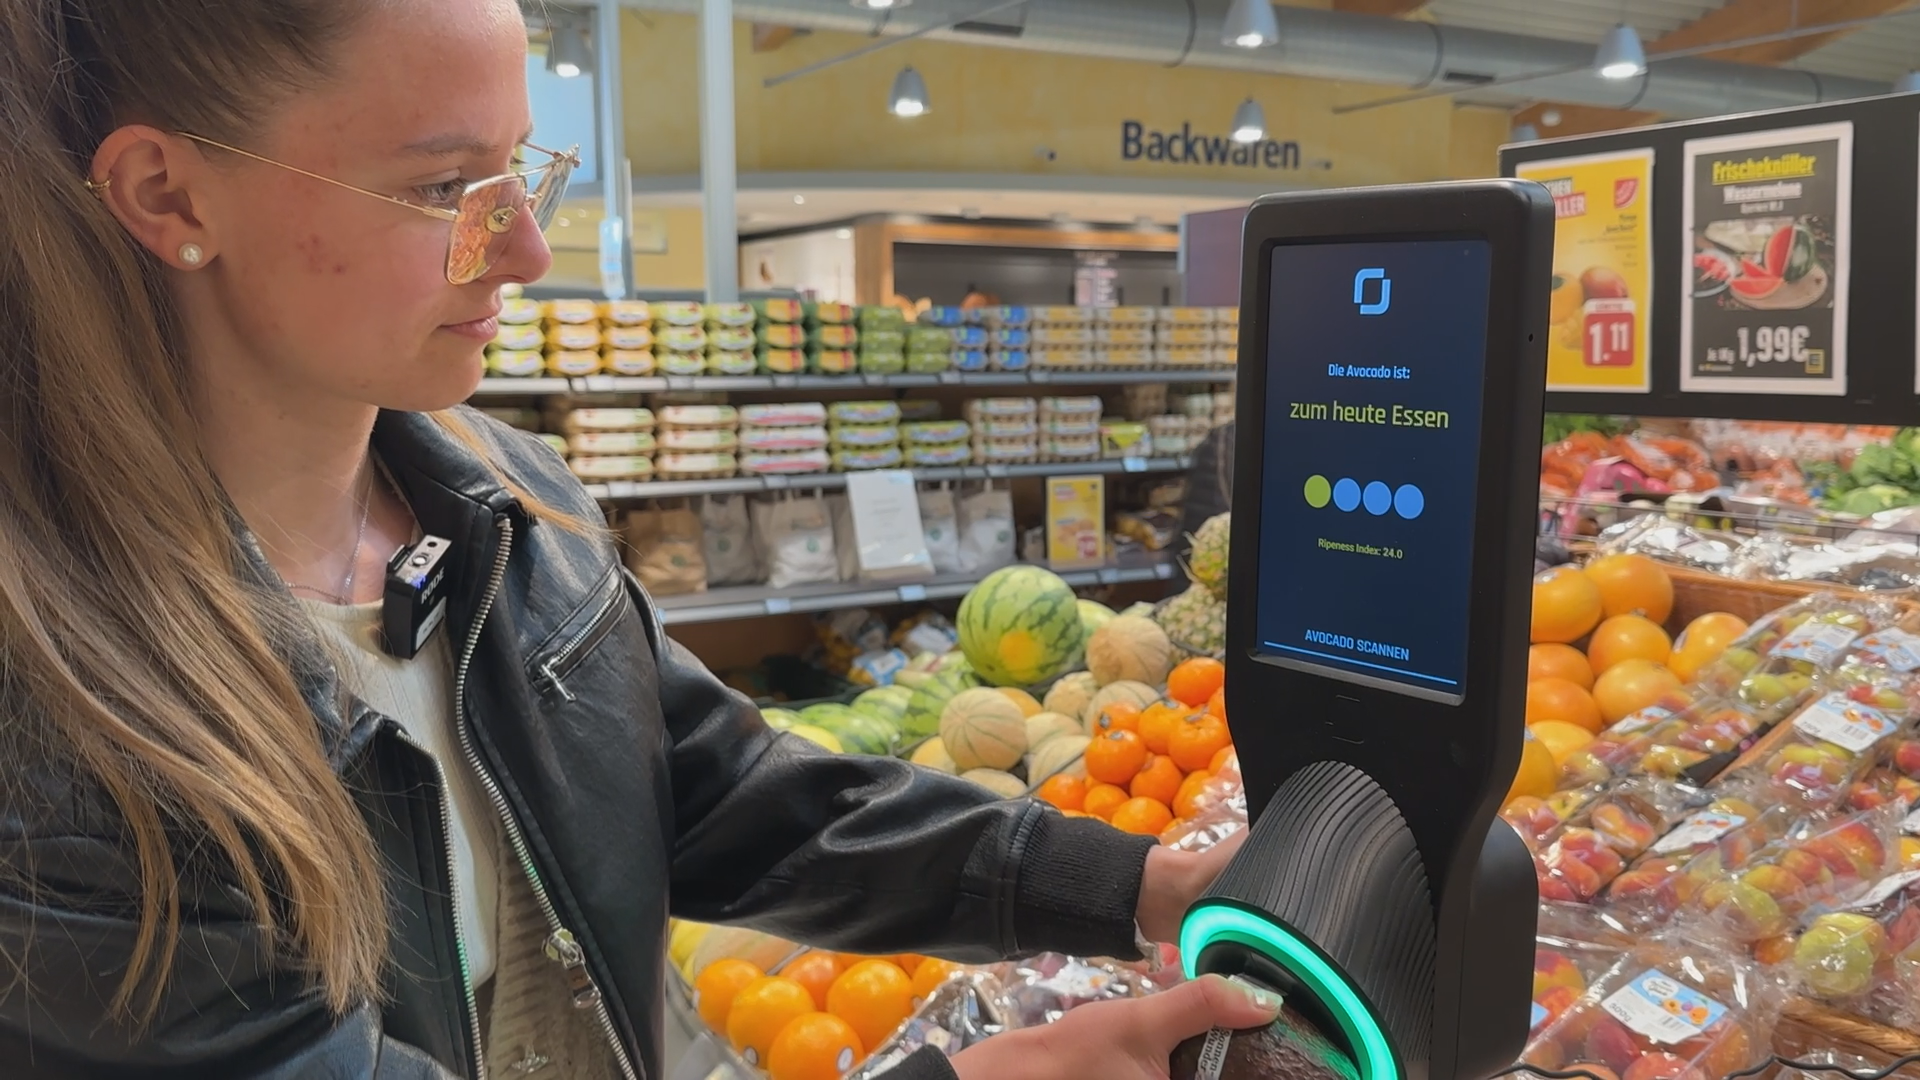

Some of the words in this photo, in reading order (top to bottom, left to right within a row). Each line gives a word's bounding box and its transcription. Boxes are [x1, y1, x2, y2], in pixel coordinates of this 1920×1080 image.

[1122, 120, 1299, 169] Backwaren
[1737, 325, 1810, 367] 1,99€
[1328, 363, 1345, 377] Die
[1346, 364, 1391, 378] Avocado
[1393, 366, 1411, 379] ist:
[1289, 402, 1327, 420] zum
[1332, 400, 1386, 424] heute
[1392, 404, 1449, 428] Essen
[1318, 538, 1355, 553] Ripeness
[1356, 543, 1381, 556] Index:
[1382, 547, 1403, 559] 24.0
[1305, 629, 1354, 650] AVOCADO
[1357, 639, 1410, 661] SCANNEN
[1200, 1026, 1221, 1072] Wunder
